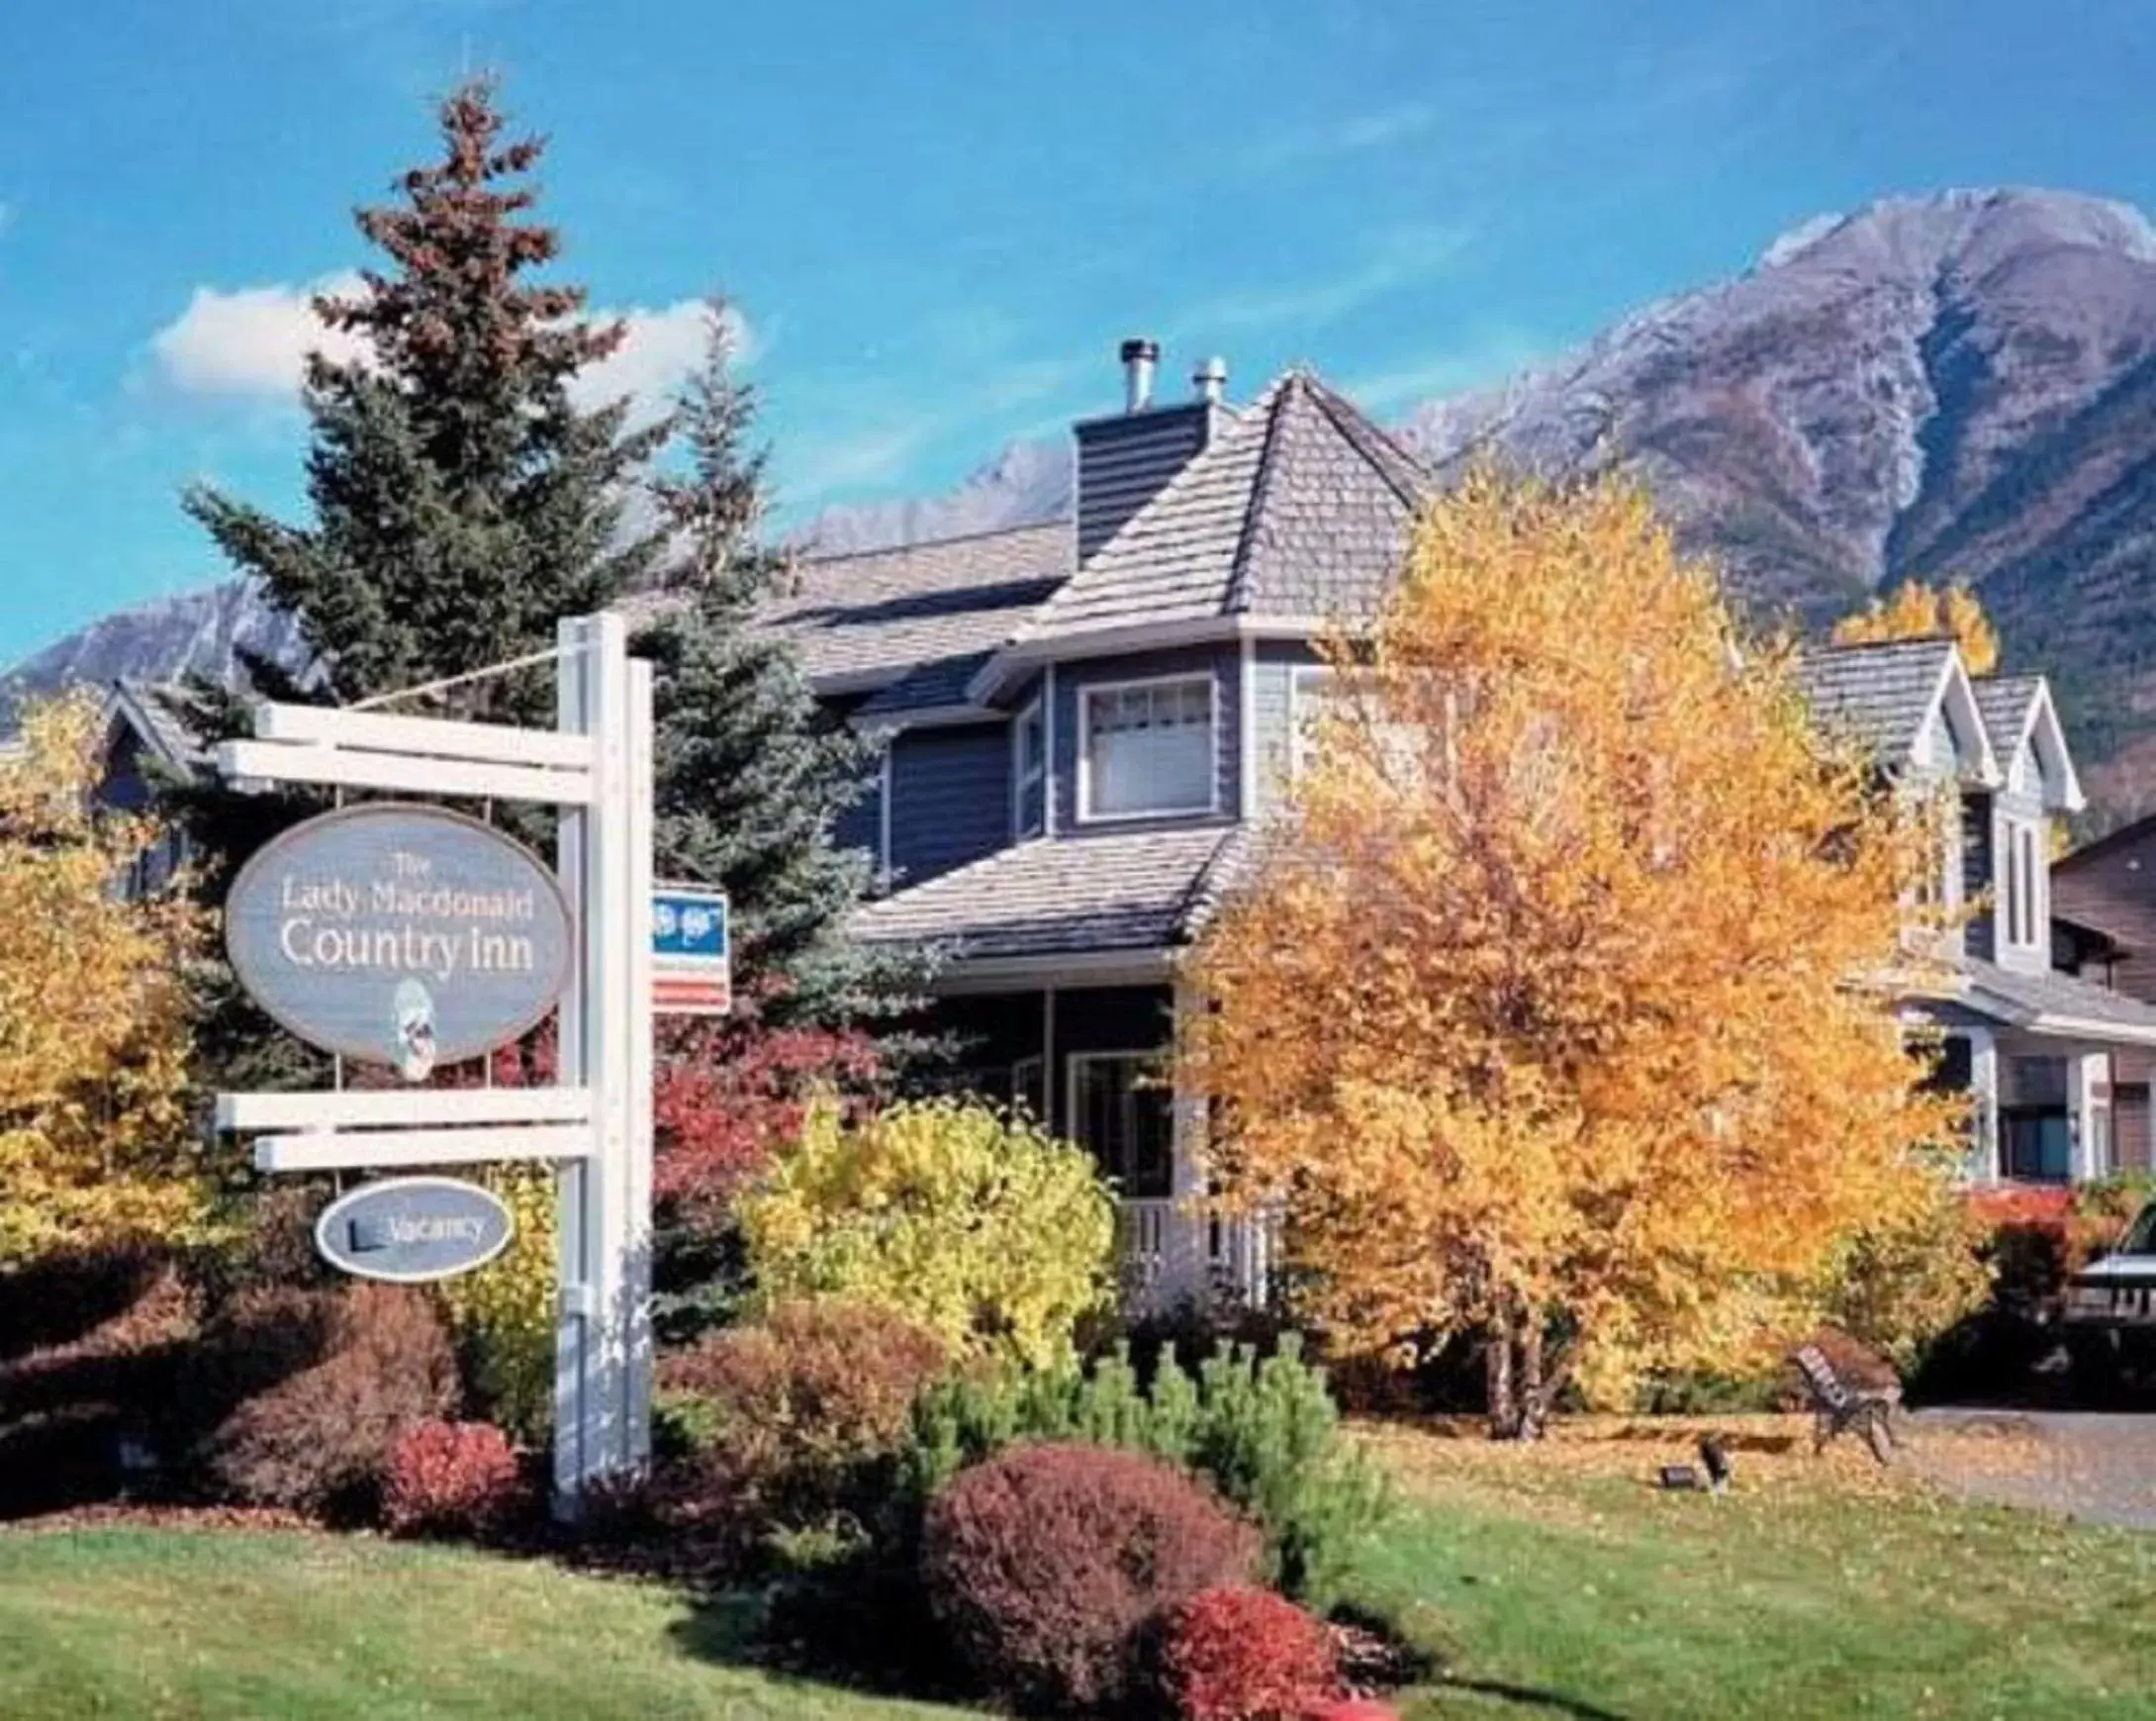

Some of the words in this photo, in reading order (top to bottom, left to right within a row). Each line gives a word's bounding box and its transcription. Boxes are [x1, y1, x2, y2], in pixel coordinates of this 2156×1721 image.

[393, 851, 431, 877] The
[281, 875, 359, 916] Lady
[371, 880, 533, 919] Macdonald
[280, 917, 459, 980] Country
[389, 1215, 486, 1245] Vacancy
